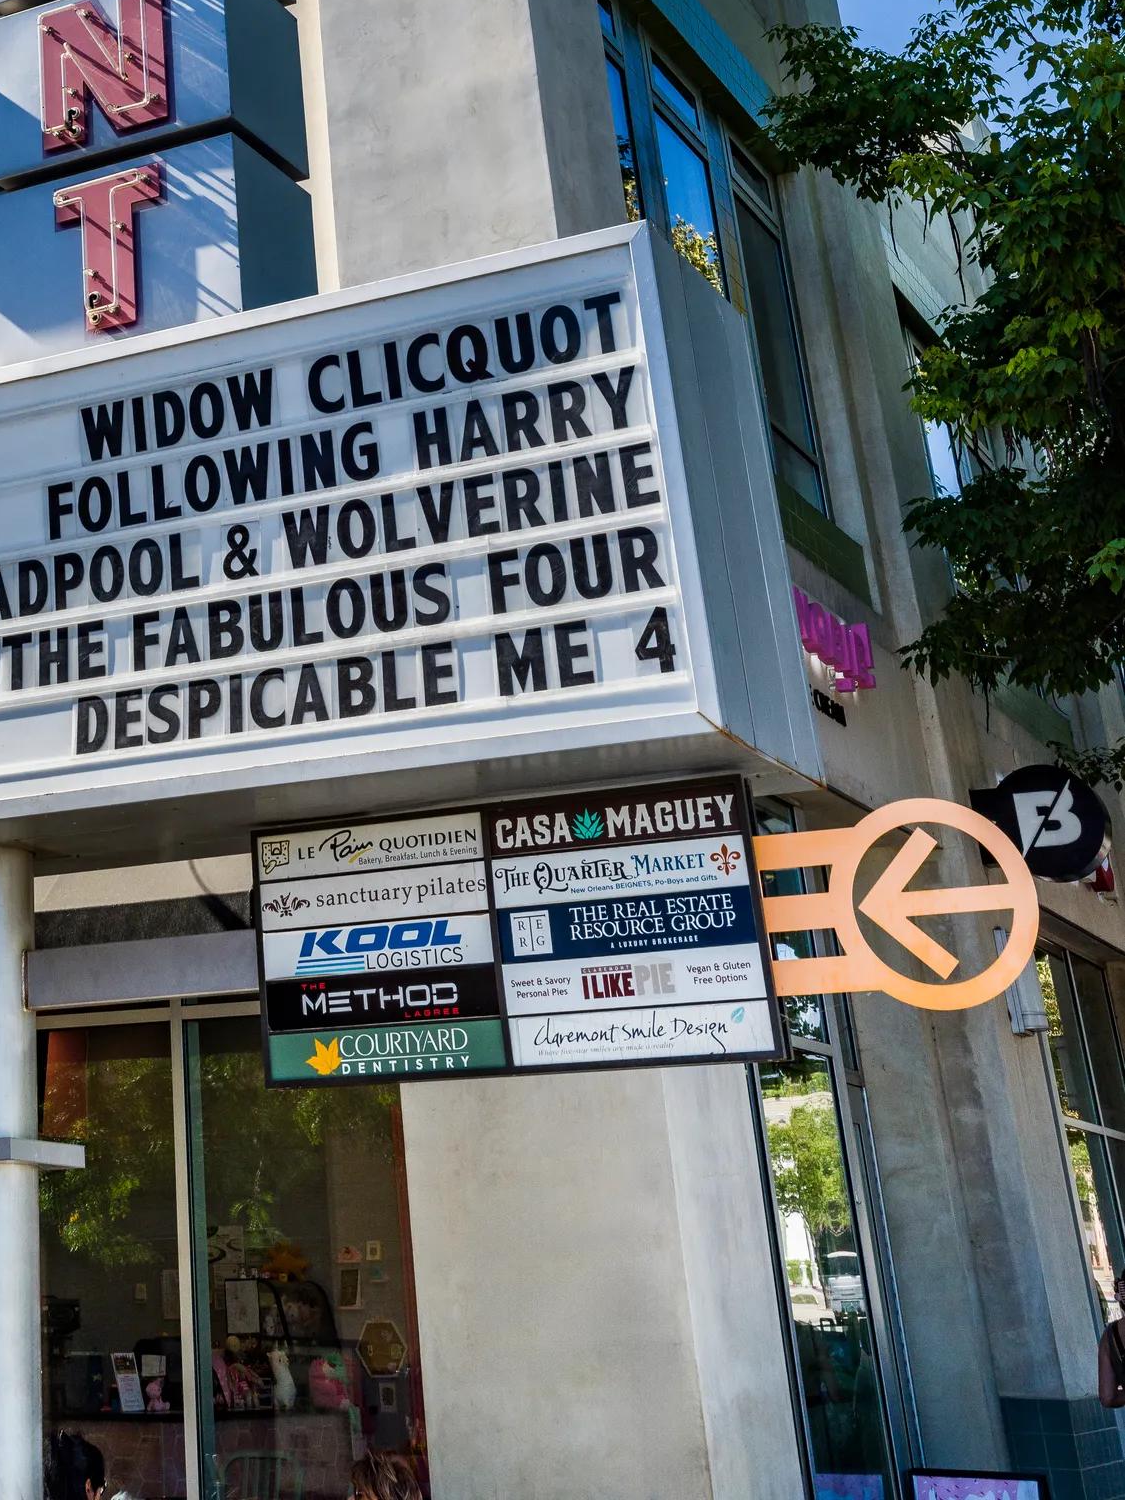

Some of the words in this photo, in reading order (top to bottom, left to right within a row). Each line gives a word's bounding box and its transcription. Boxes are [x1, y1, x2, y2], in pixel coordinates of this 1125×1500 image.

[81, 368, 273, 462] WIDOW
[308, 292, 621, 414] CLICQUOT
[48, 421, 380, 540] FOLLOWING
[413, 366, 635, 470] HARRY
[223, 524, 260, 581] &
[282, 442, 661, 569] WOLVERINE
[2, 621, 106, 691] THE
[132, 562, 451, 671] FABULOUS
[488, 526, 667, 614] FOUR
[76, 641, 458, 755] DESPICABLE
[495, 619, 595, 697] ME
[634, 607, 676, 673] 4
[495, 812, 573, 849] CASA
[605, 794, 734, 838] MAGUEY
[298, 846, 315, 860] LE
[319, 829, 373, 862] Pain
[379, 829, 477, 853] QUOTIDIEN
[358, 856, 383, 866] Bakery,
[385, 852, 418, 863] Breakfast,
[420, 848, 441, 859] Lunch
[442, 848, 448, 857] &
[450, 845, 478, 857] Evening
[316, 884, 413, 908] sanctuary
[417, 876, 487, 904] pilates
[570, 886, 586, 895] New
[587, 884, 614, 893] Orleans
[616, 880, 654, 890] BEIGNETS,
[655, 876, 684, 887] Po-Boys
[686, 874, 699, 883] and
[701, 873, 718, 883] Gifts
[569, 905, 607, 923] THE
[609, 900, 661, 920] REAL
[665, 893, 734, 915] ESTATE
[299, 920, 462, 958] KOOL
[518, 921, 526, 931] R
[536, 919, 543, 929] E
[570, 917, 666, 941] RESOURCE
[672, 910, 737, 933] GROUP
[519, 937, 528, 948] R
[537, 935, 545, 946] G
[618, 939, 648, 949] LUXURY
[652, 934, 699, 946] BROKERAGE
[366, 946, 464, 970] LOGISTICS
[582, 964, 630, 974] CLAREMONT
[686, 965, 712, 976] Vegan
[714, 963, 720, 972] &
[722, 960, 751, 971] Gluten
[301, 982, 326, 990] THE
[511, 978, 535, 988] Sweet
[537, 977, 543, 986] &
[545, 976, 571, 988] Savory
[516, 989, 550, 999] Personal
[551, 987, 568, 997] Pies
[582, 976, 590, 1000] I
[591, 972, 635, 999] LIKE
[635, 963, 676, 996] PIE
[693, 976, 713, 985] Free
[715, 973, 748, 986] Options
[301, 982, 458, 1016] METHOD
[404, 1007, 460, 1018] LAGREE
[340, 1028, 468, 1057] COURTYARD
[624, 1011, 667, 1041] Smile
[670, 1018, 729, 1054] Design
[342, 1055, 470, 1075] DENTISTRY
